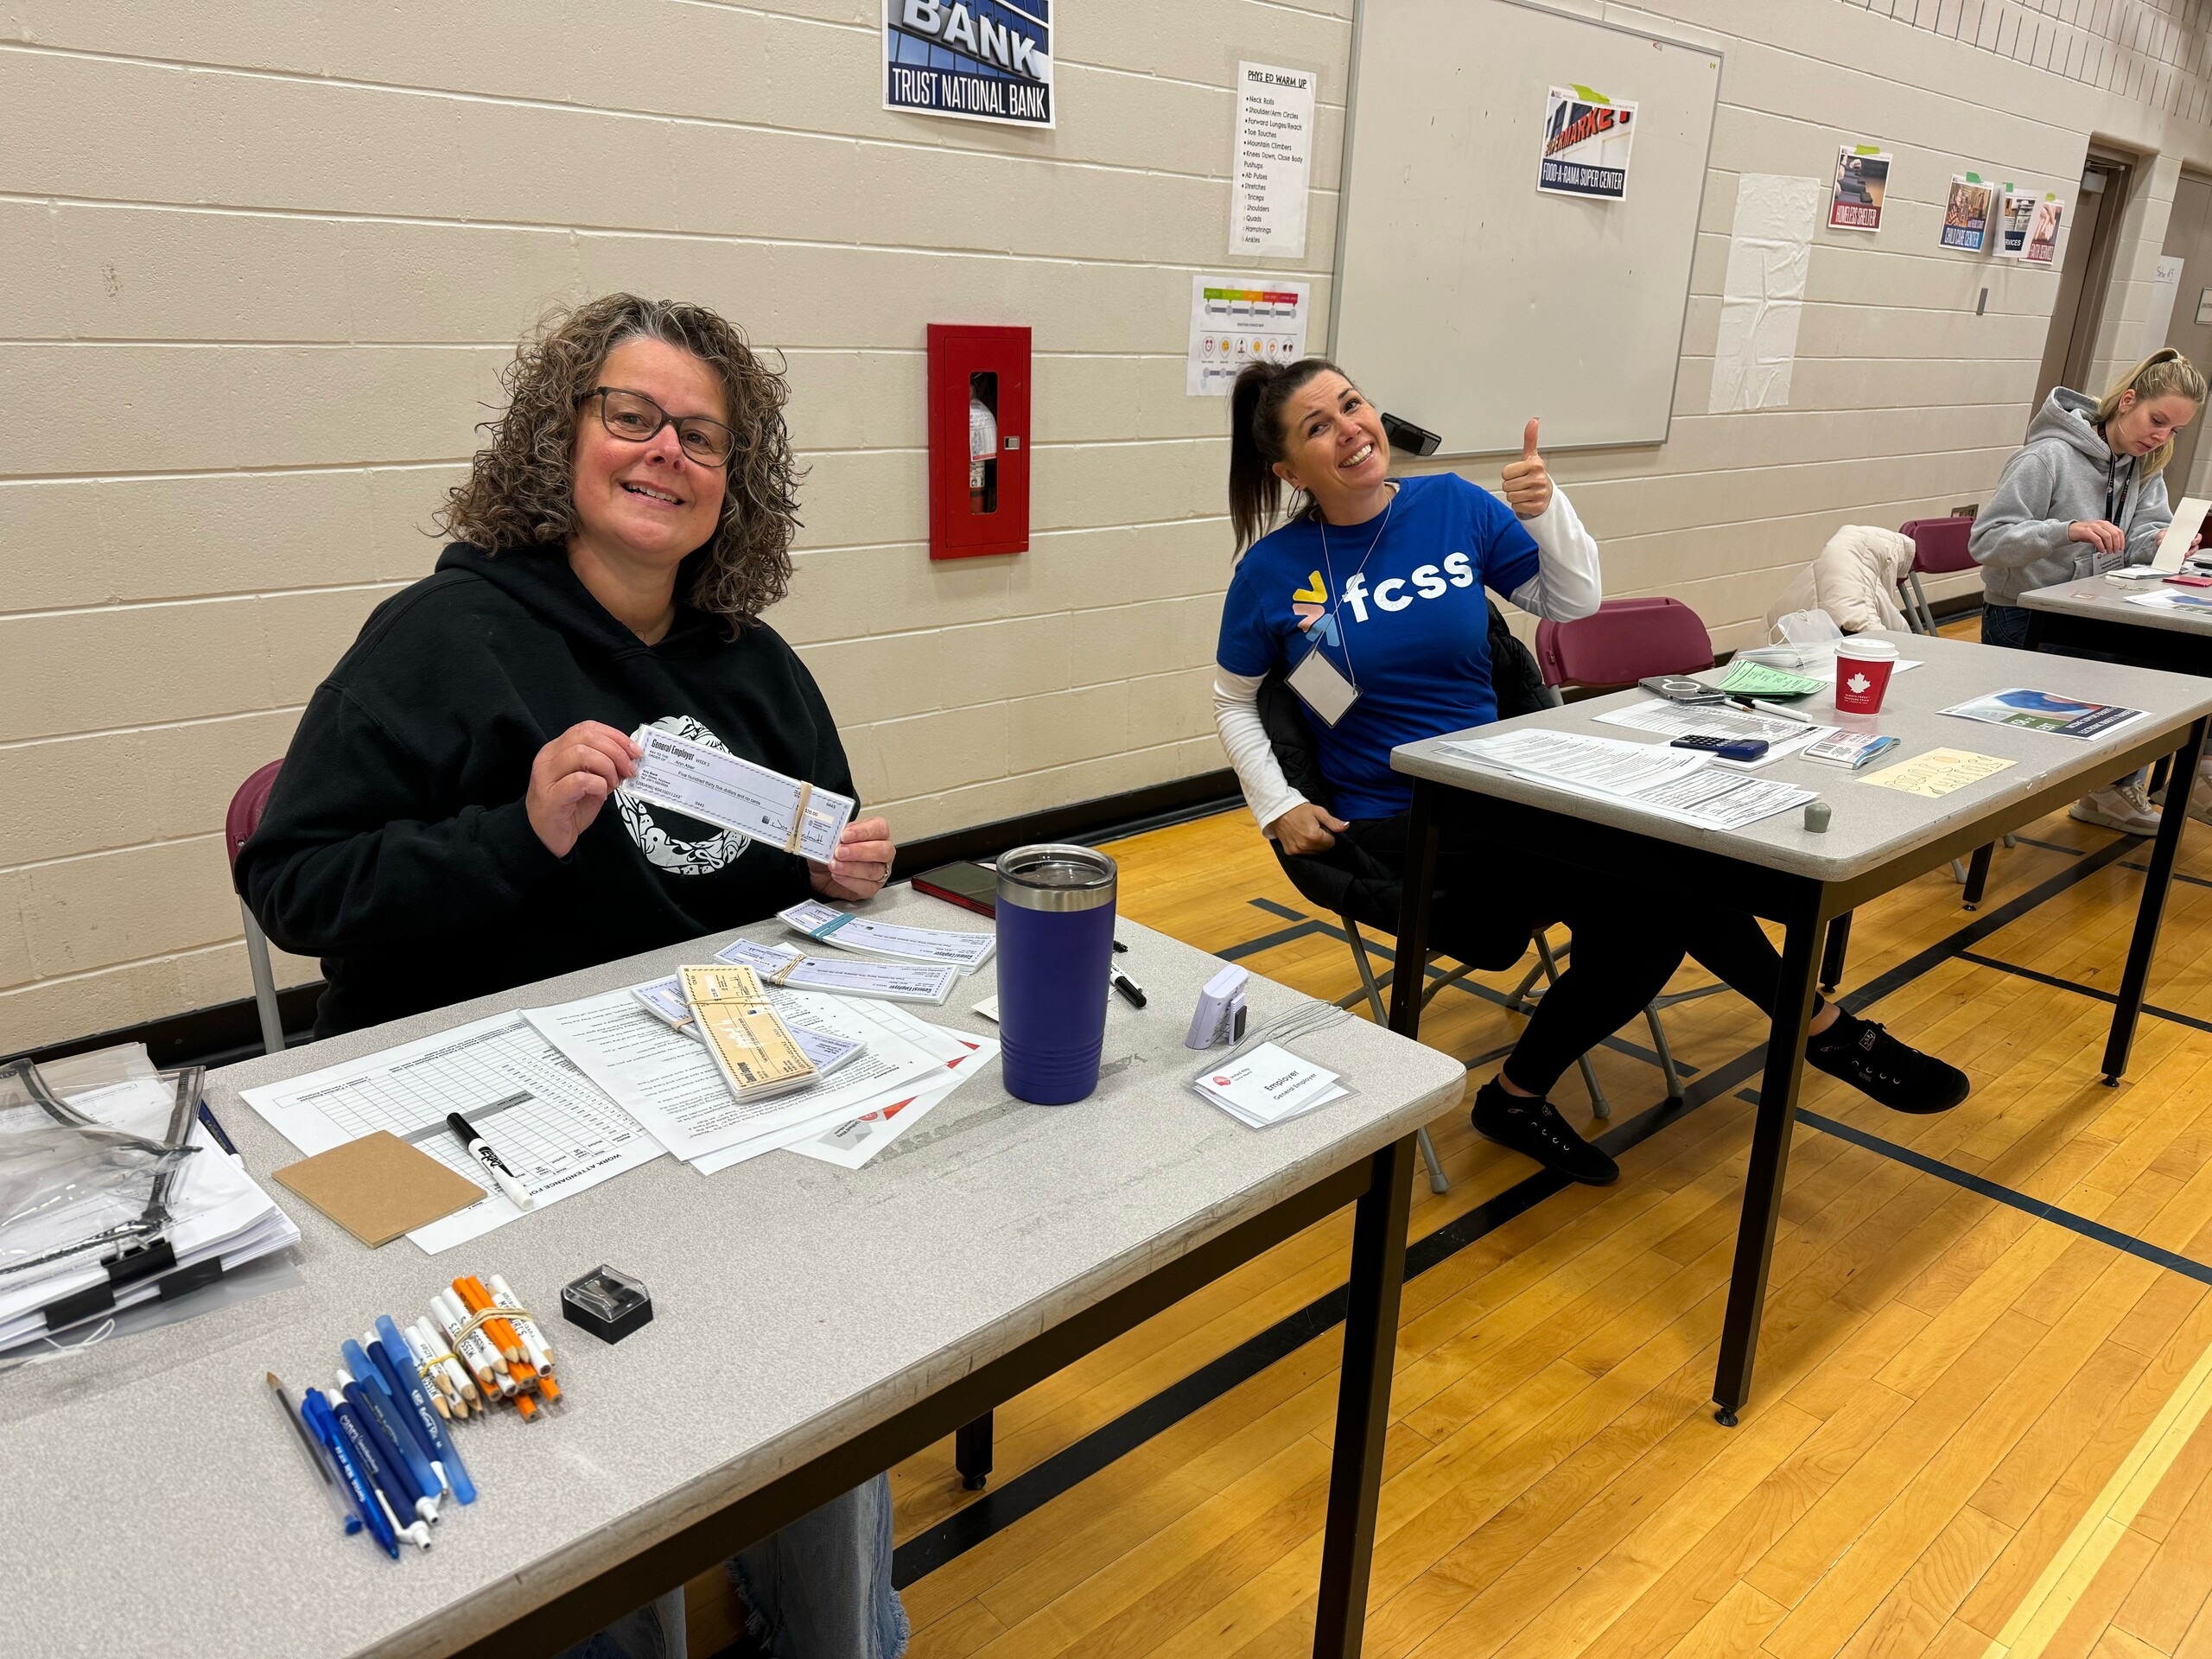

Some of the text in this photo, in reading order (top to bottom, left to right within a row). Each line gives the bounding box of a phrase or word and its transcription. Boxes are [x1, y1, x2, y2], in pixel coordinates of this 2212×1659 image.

[903, 0, 1041, 79] BANK
[1249, 70, 1306, 87] PHYS ED WARM UP
[893, 67, 1046, 118] TRUST NATIONAL BANK
[1248, 118, 1268, 126] Forward
[1258, 130, 1276, 138] Touches
[1271, 142, 1292, 150] Climbers
[1244, 161, 1263, 169] Pushups
[1292, 156, 1303, 164] Body
[1542, 162, 1623, 190] FOOD-A-RAMA SUPER CENTER
[1248, 194, 1264, 202] Triceps
[1835, 205, 1877, 226] HOMELESS SHELTER
[1245, 226, 1271, 234] Hamstrings
[1964, 231, 1980, 247] CENTER
[1342, 551, 1473, 623] fcss
[651, 739, 671, 753] General
[670, 746, 695, 762] Employer
[686, 773, 704, 785] hundred
[703, 779, 715, 789] thirty
[721, 786, 737, 797] dollars
[1264, 1070, 1299, 1090] Employer
[1274, 1073, 1317, 1100] General Employer
[480, 1149, 502, 1167] EXPO
[594, 1153, 622, 1166] WORK
[542, 1163, 597, 1190] ATTENDANCE
